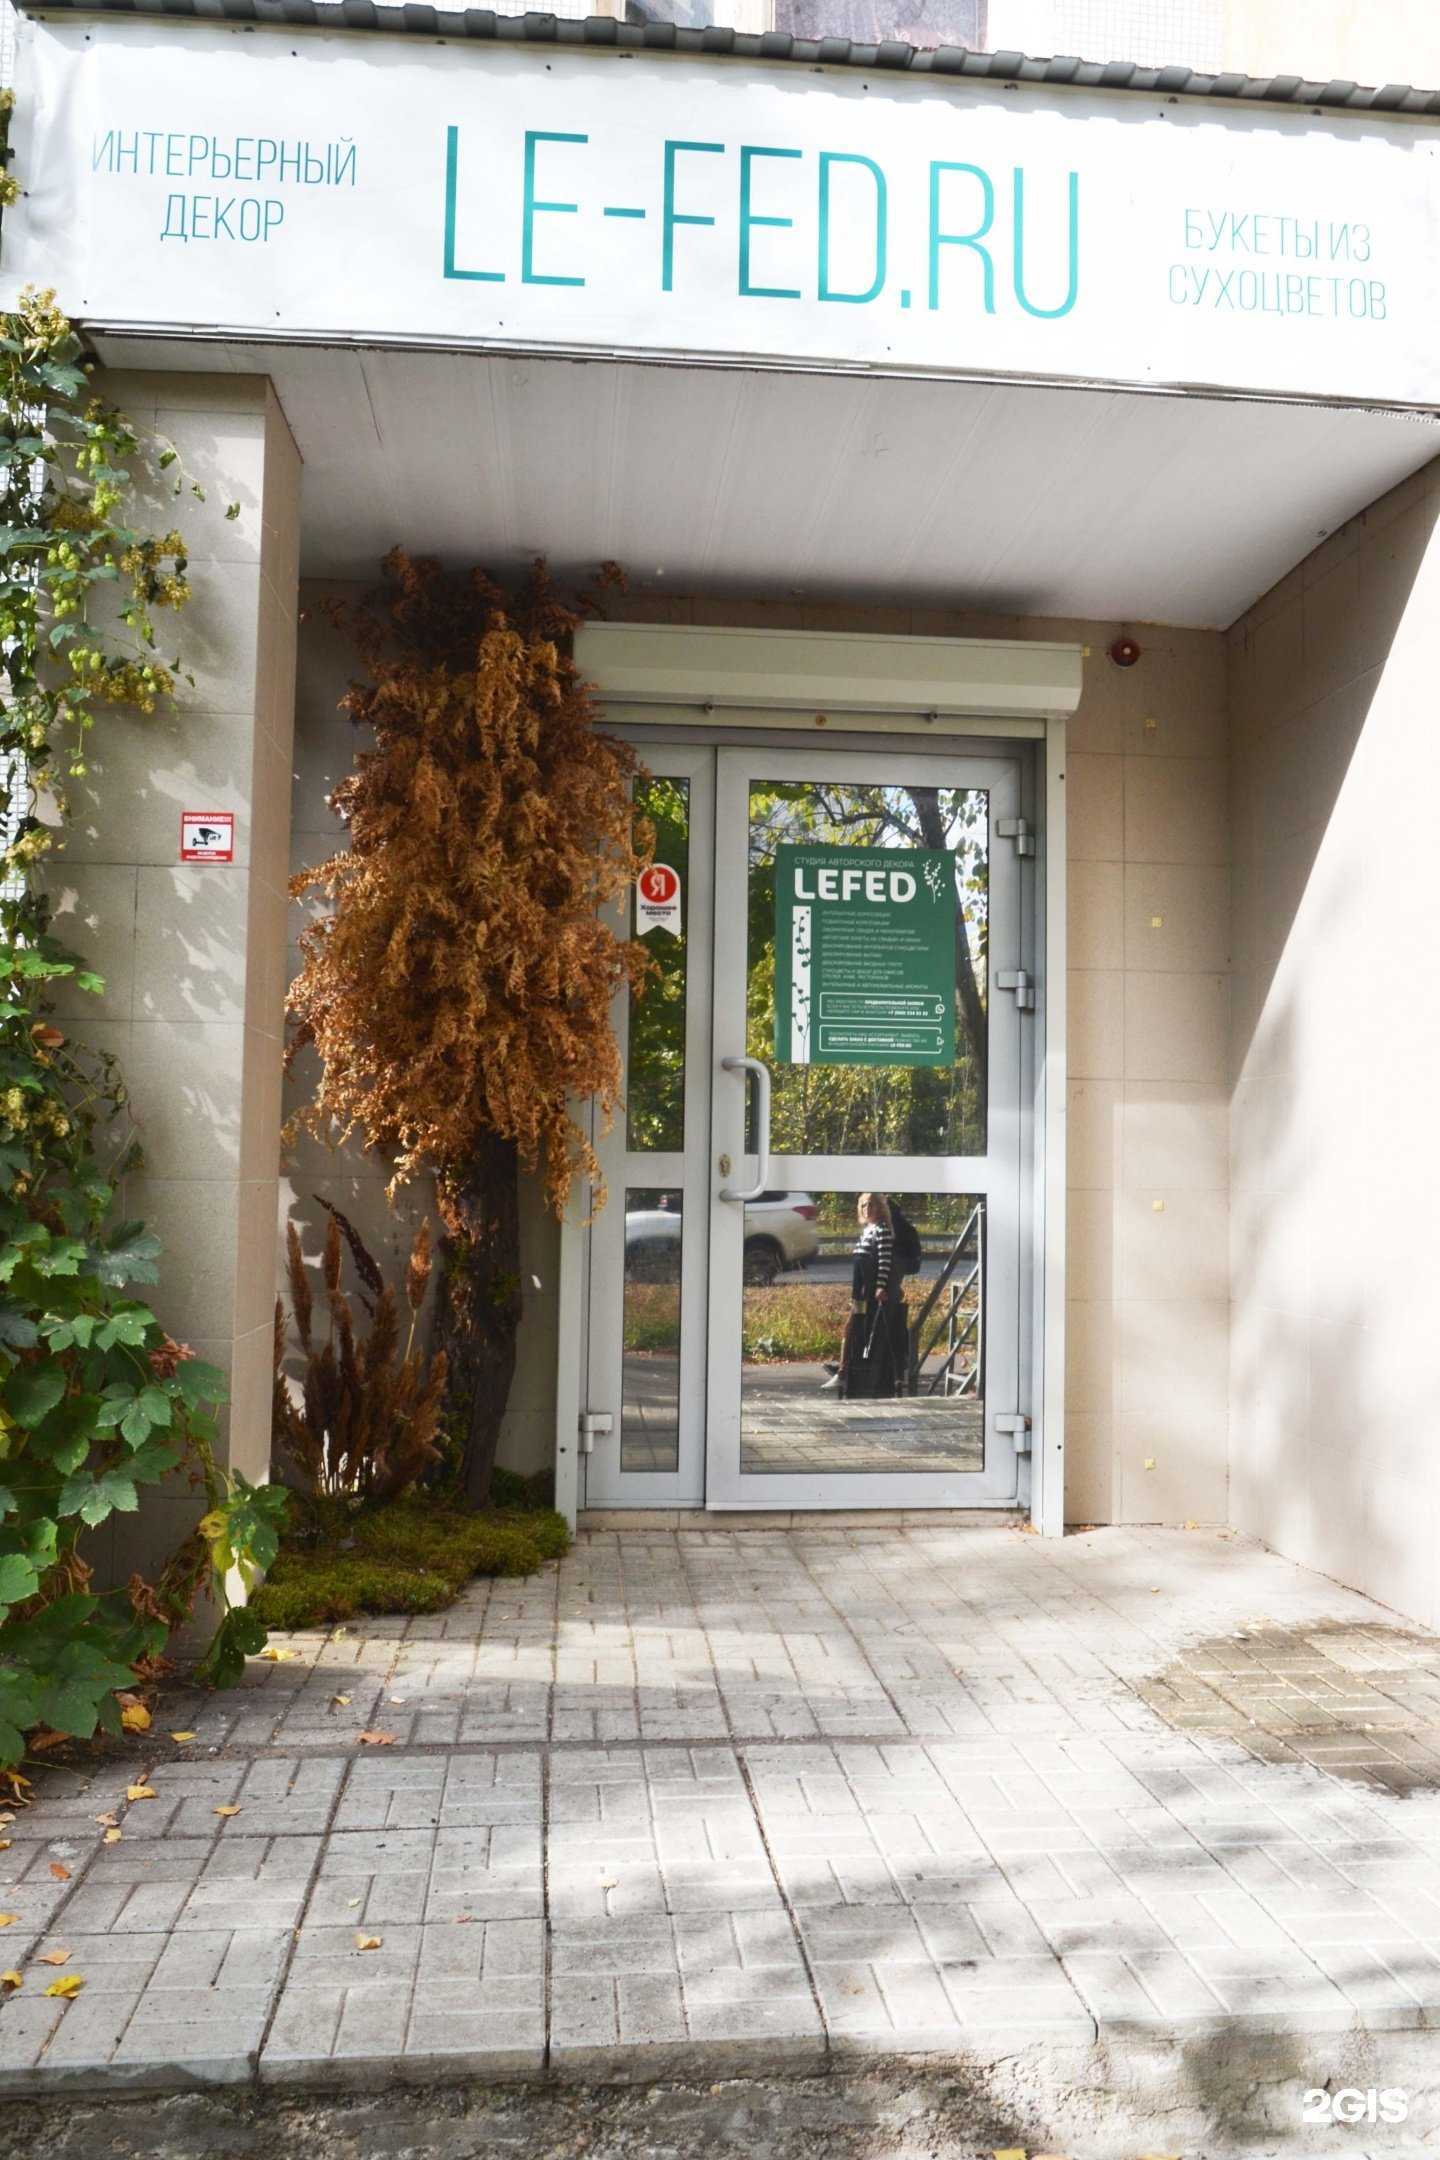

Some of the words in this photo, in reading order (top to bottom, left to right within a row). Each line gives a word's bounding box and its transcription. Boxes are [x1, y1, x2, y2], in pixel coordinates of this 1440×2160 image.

[92, 130, 358, 187] ИНТЕРЬЕРНЫЙ
[160, 194, 285, 243] ДЕКОР
[443, 125, 1079, 319] LE-FED.RU
[1184, 209, 1319, 261] БУКЕТЫ
[1330, 222, 1372, 263] ИЗ
[1168, 264, 1388, 321] СУХОЦВЕТОВ
[794, 868, 917, 903] LEFED
